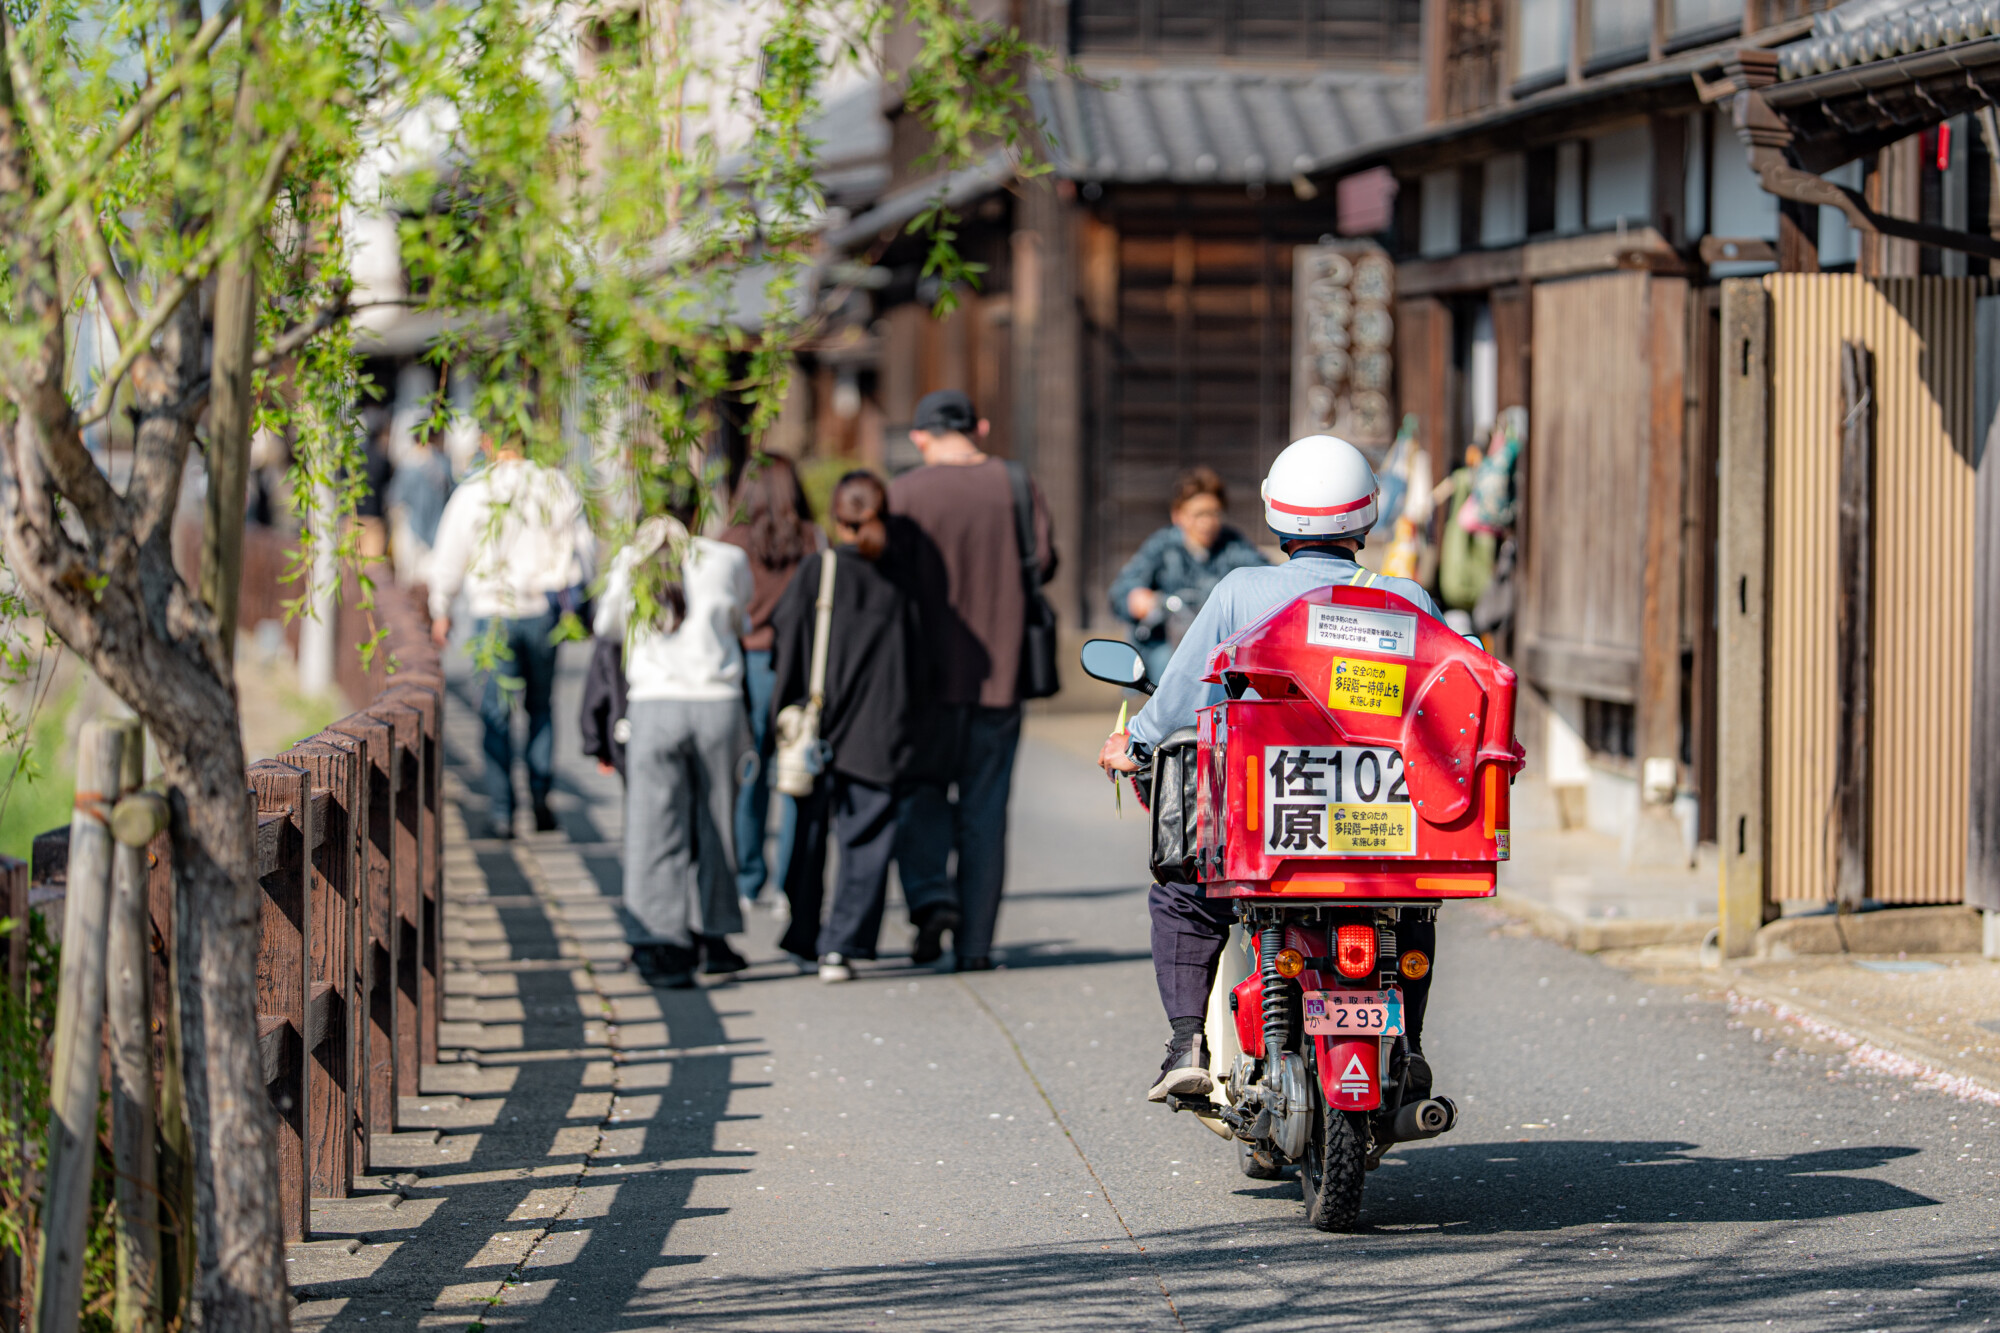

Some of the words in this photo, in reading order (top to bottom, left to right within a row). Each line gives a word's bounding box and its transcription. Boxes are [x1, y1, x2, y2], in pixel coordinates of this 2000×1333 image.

[1352, 665, 1386, 679] 安全のため
[1335, 676, 1400, 698] 多段階一時停止を
[1349, 695, 1382, 708] 実施します
[1327, 750, 1411, 803] 102
[1351, 811, 1388, 821] 安全のため
[1334, 822, 1405, 836] 多段階一時停止を
[1351, 837, 1387, 847] 実施します
[1333, 996, 1374, 1005] 香取市
